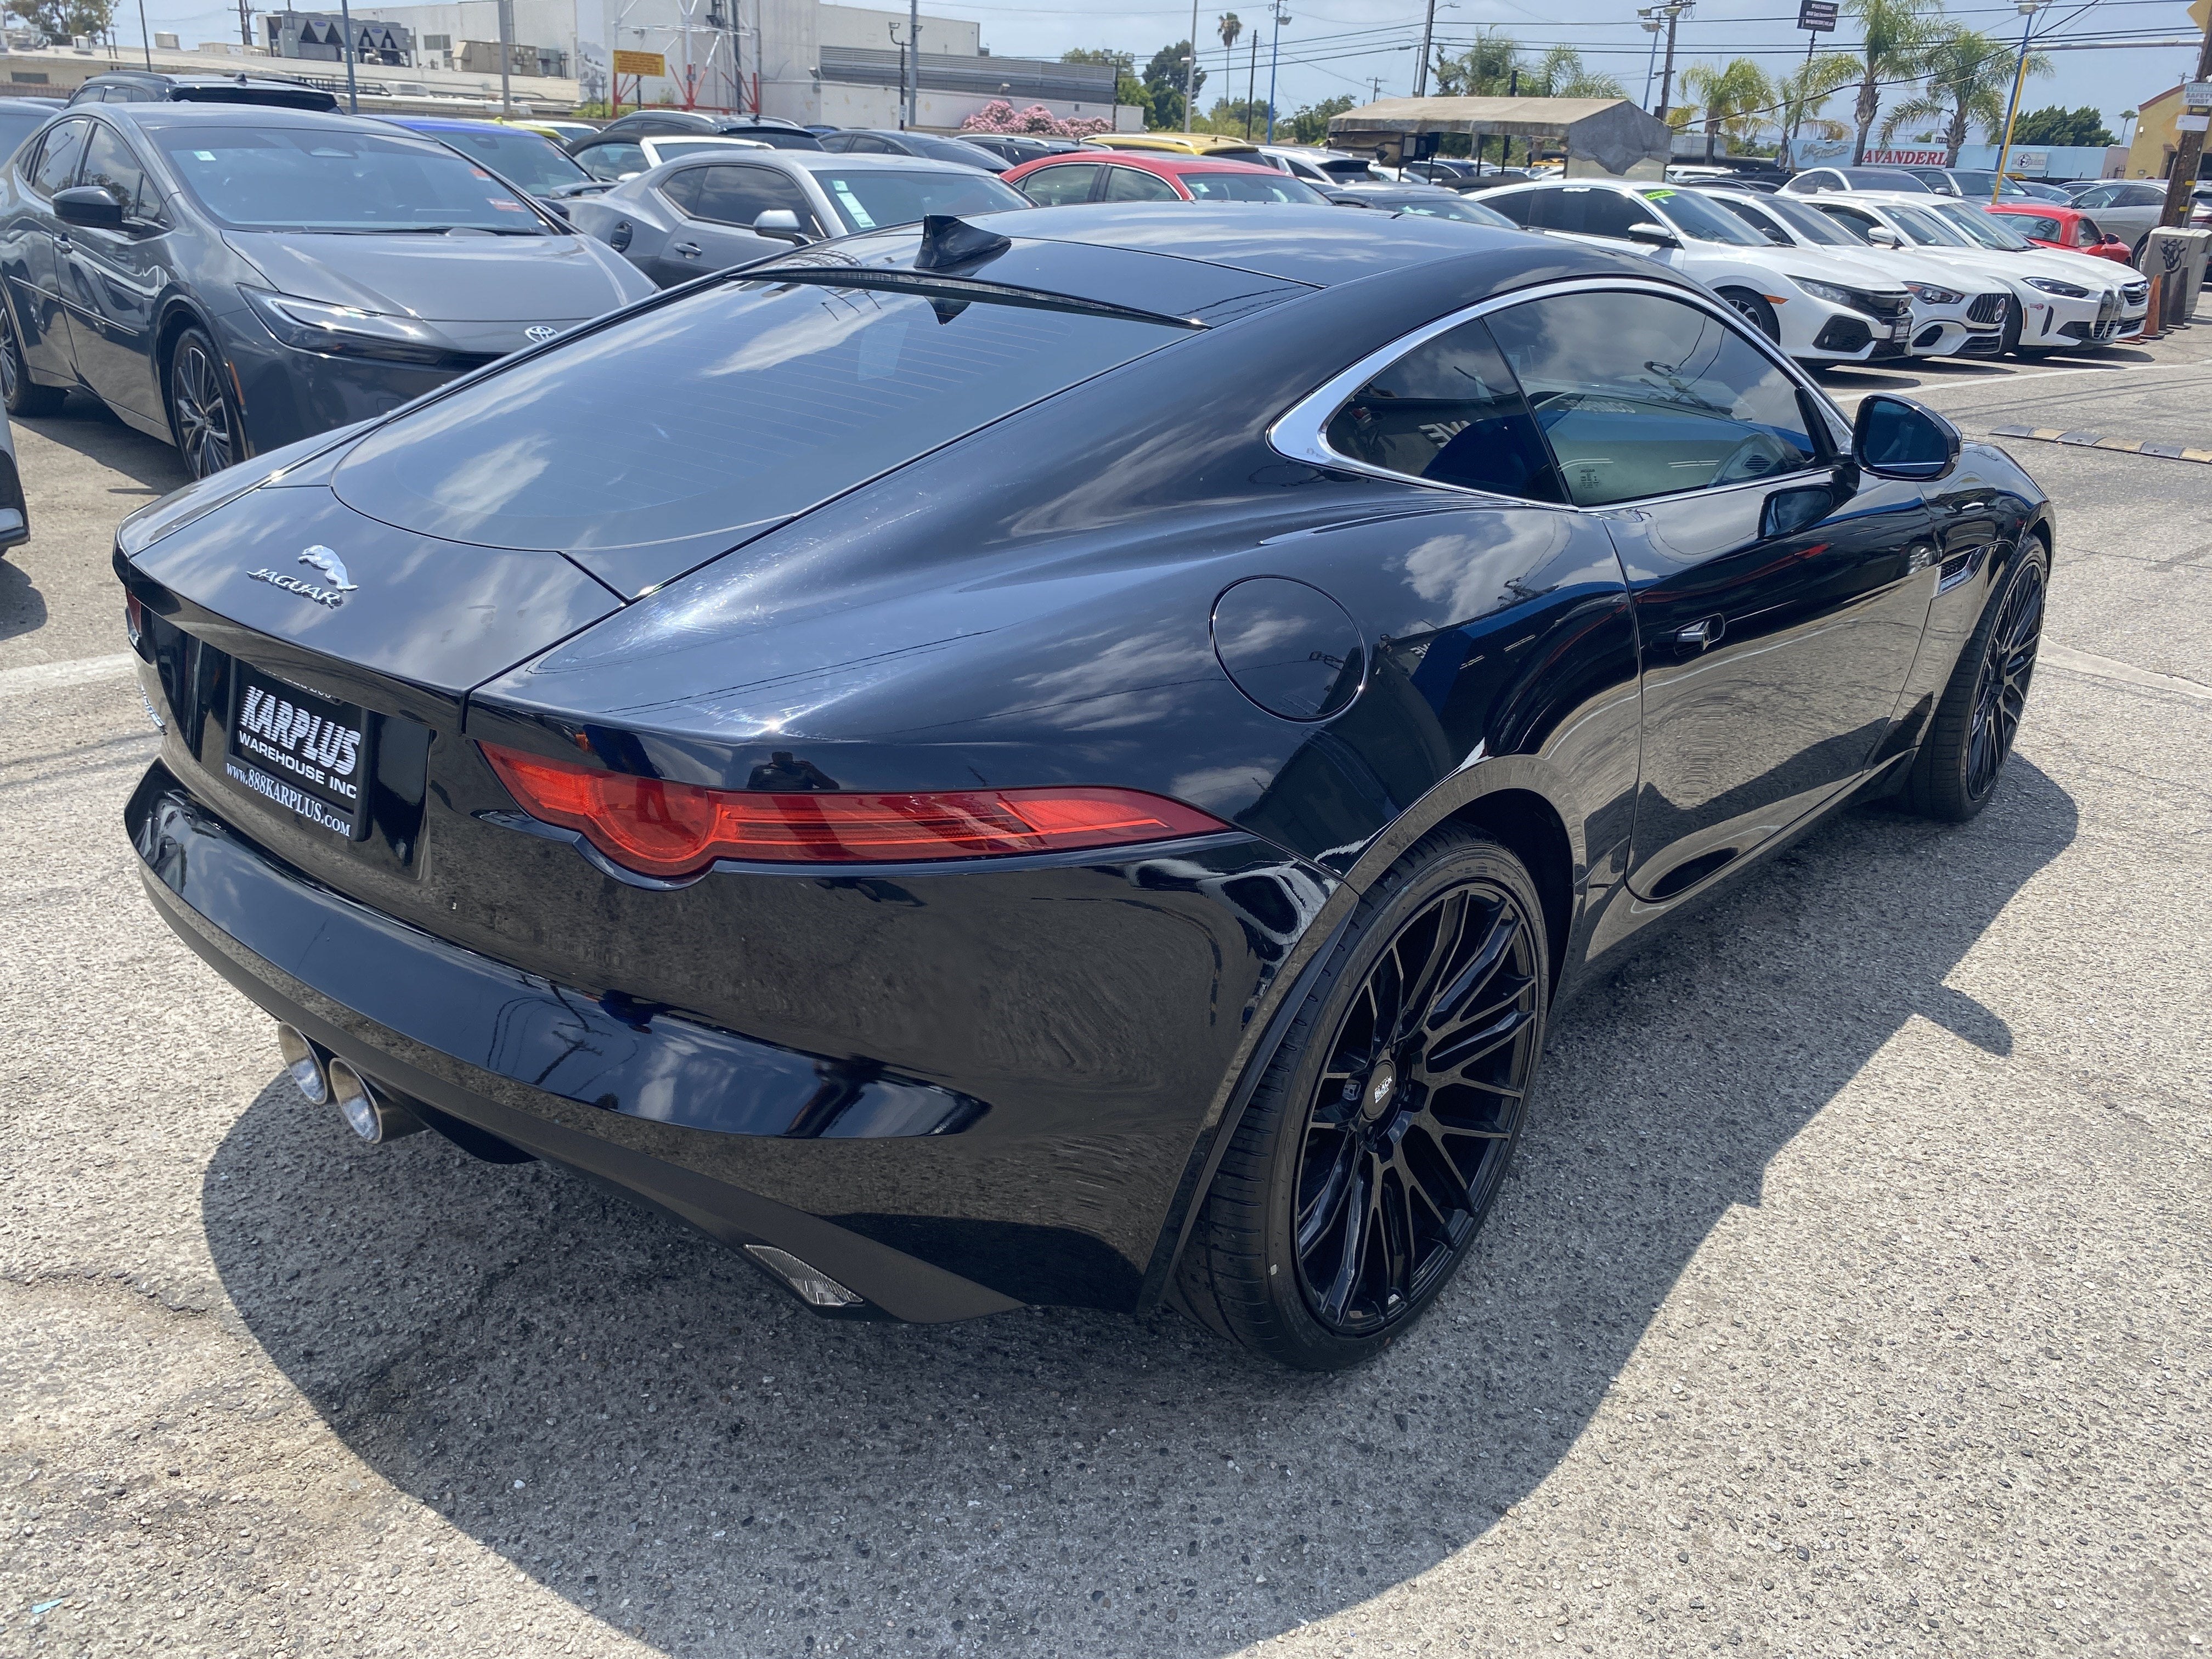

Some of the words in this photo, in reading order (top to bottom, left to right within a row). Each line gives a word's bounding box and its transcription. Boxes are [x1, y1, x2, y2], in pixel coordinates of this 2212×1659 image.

[1862, 150, 1946, 165] AVANDERI
[246, 568, 342, 608] JAGUAR
[239, 686, 361, 775] KARPLUS
[239, 730, 325, 785] WAREHOUSE
[329, 776, 357, 799] INC
